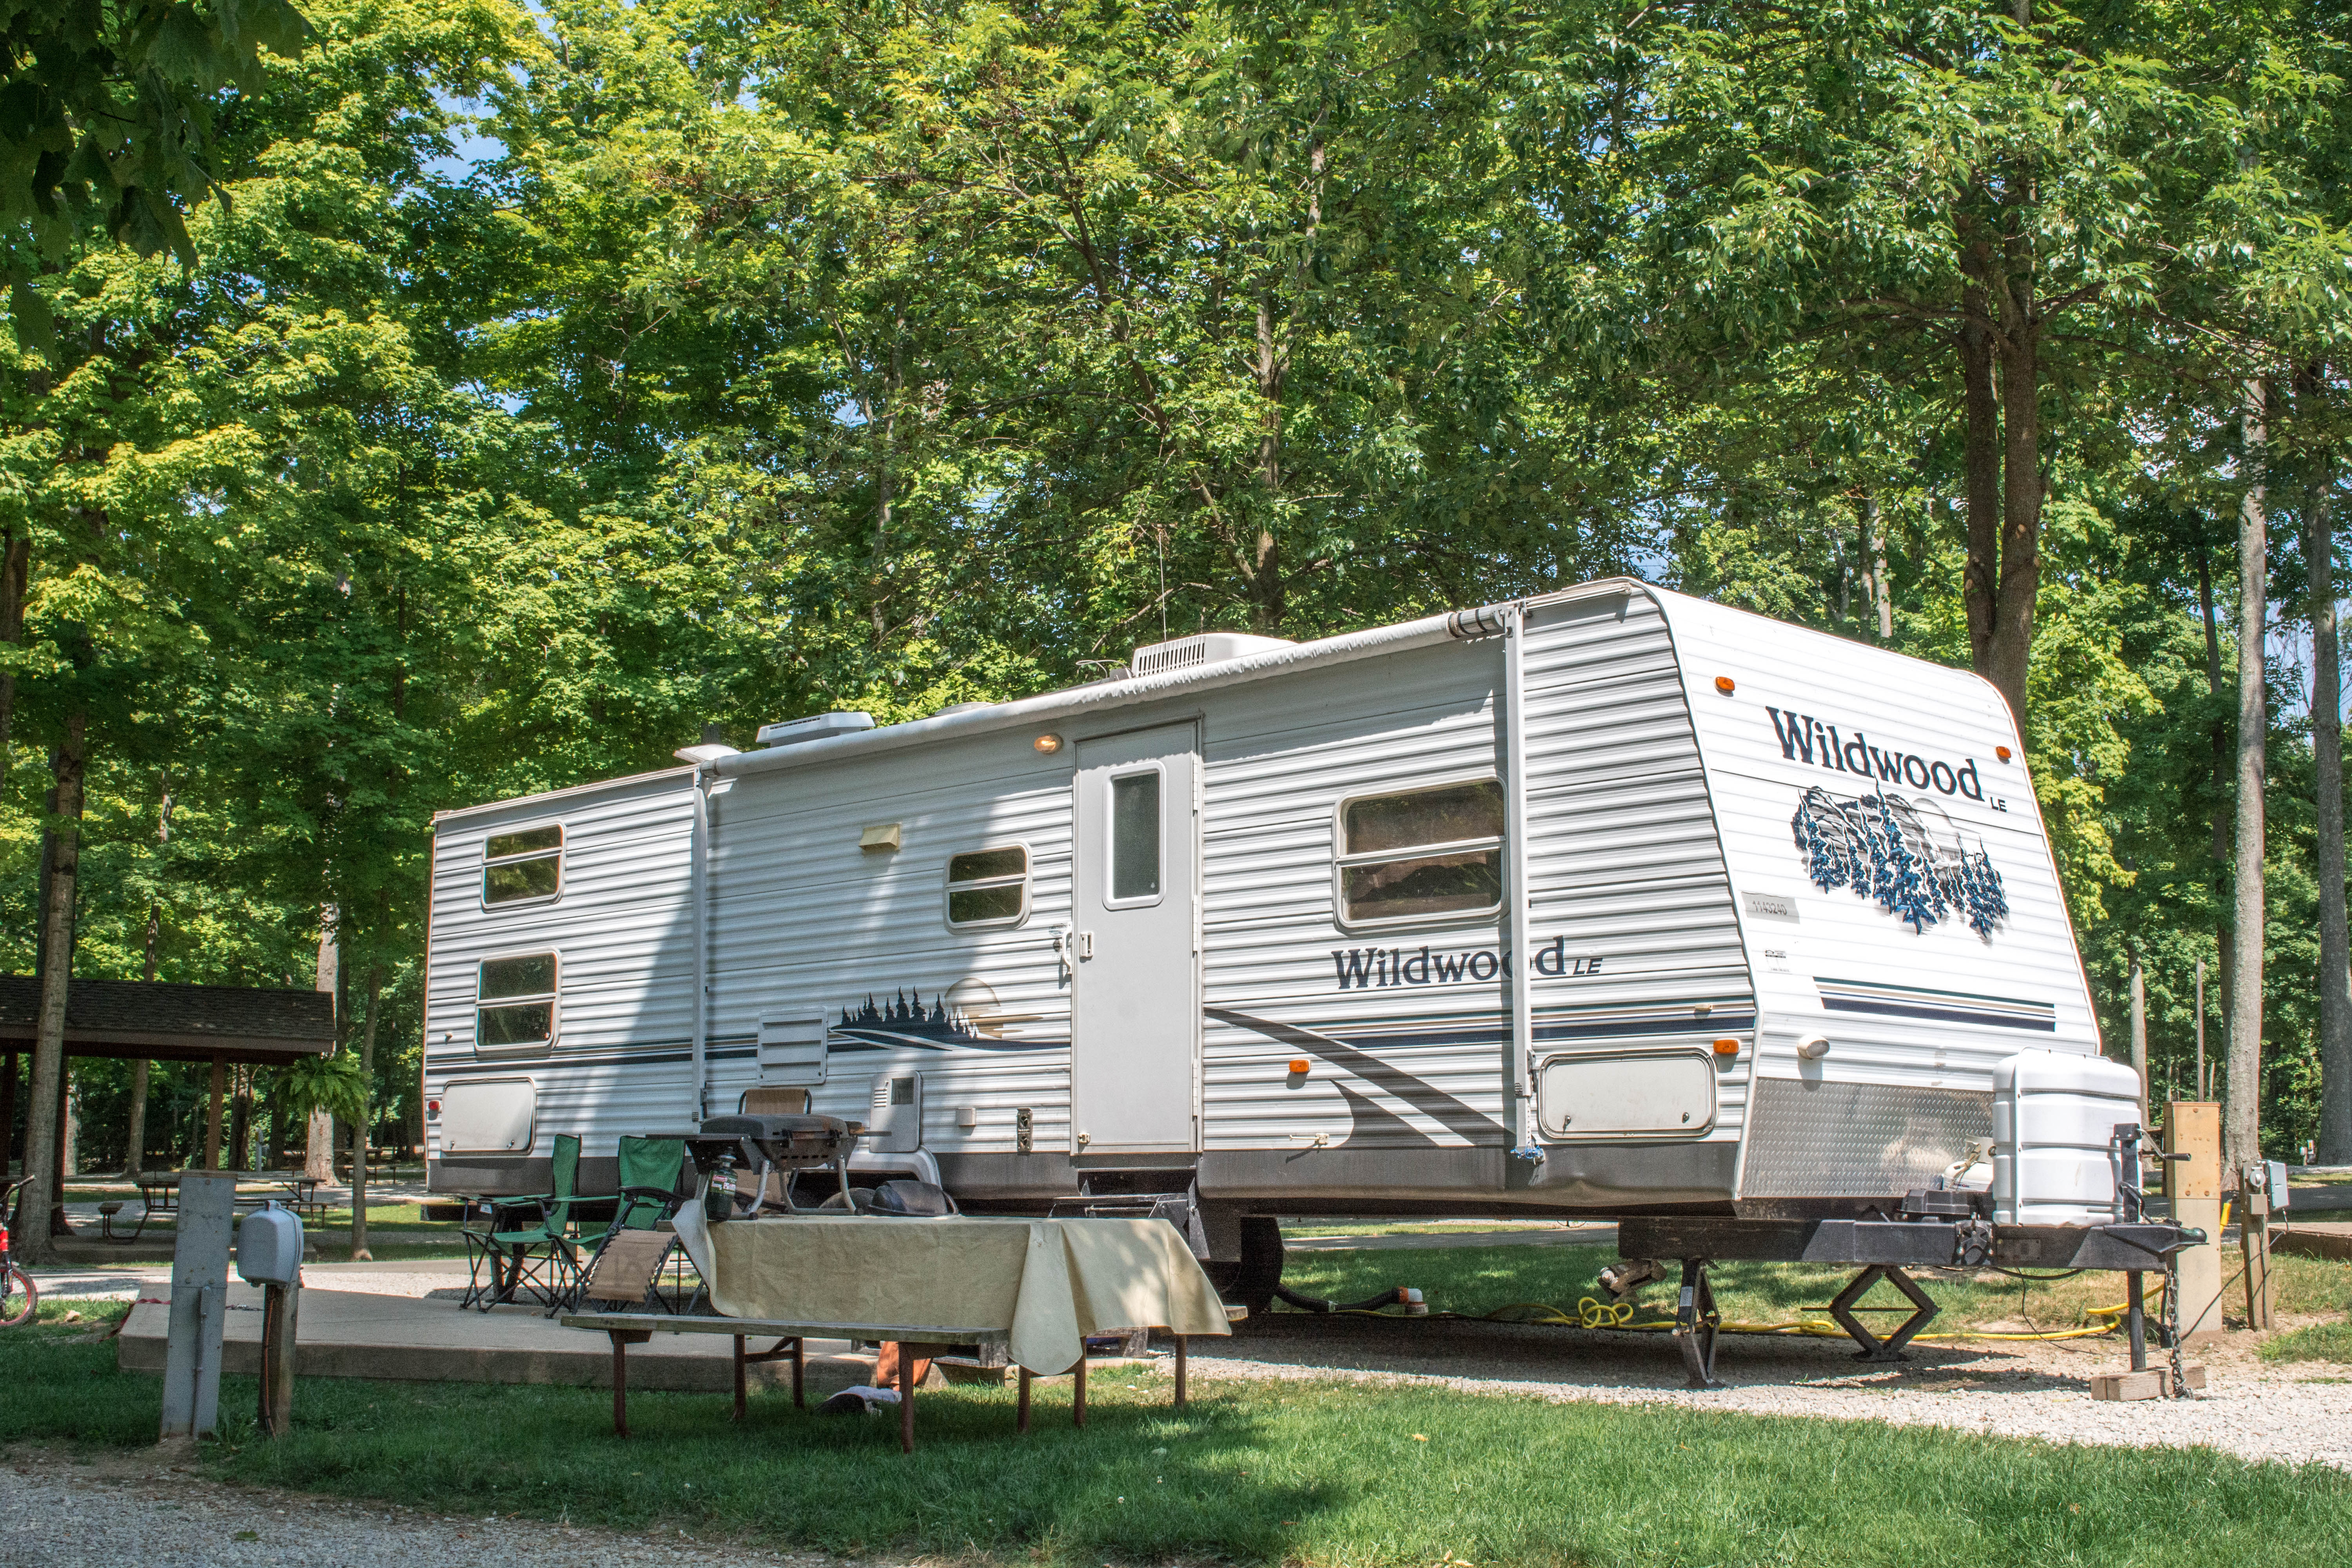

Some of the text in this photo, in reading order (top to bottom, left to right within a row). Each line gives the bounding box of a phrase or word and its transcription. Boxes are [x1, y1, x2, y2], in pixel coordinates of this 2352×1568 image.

[1766, 706, 2007, 812] Wildwood LE
[1753, 900, 1787, 915] 1143240
[1573, 957, 1603, 975] LE
